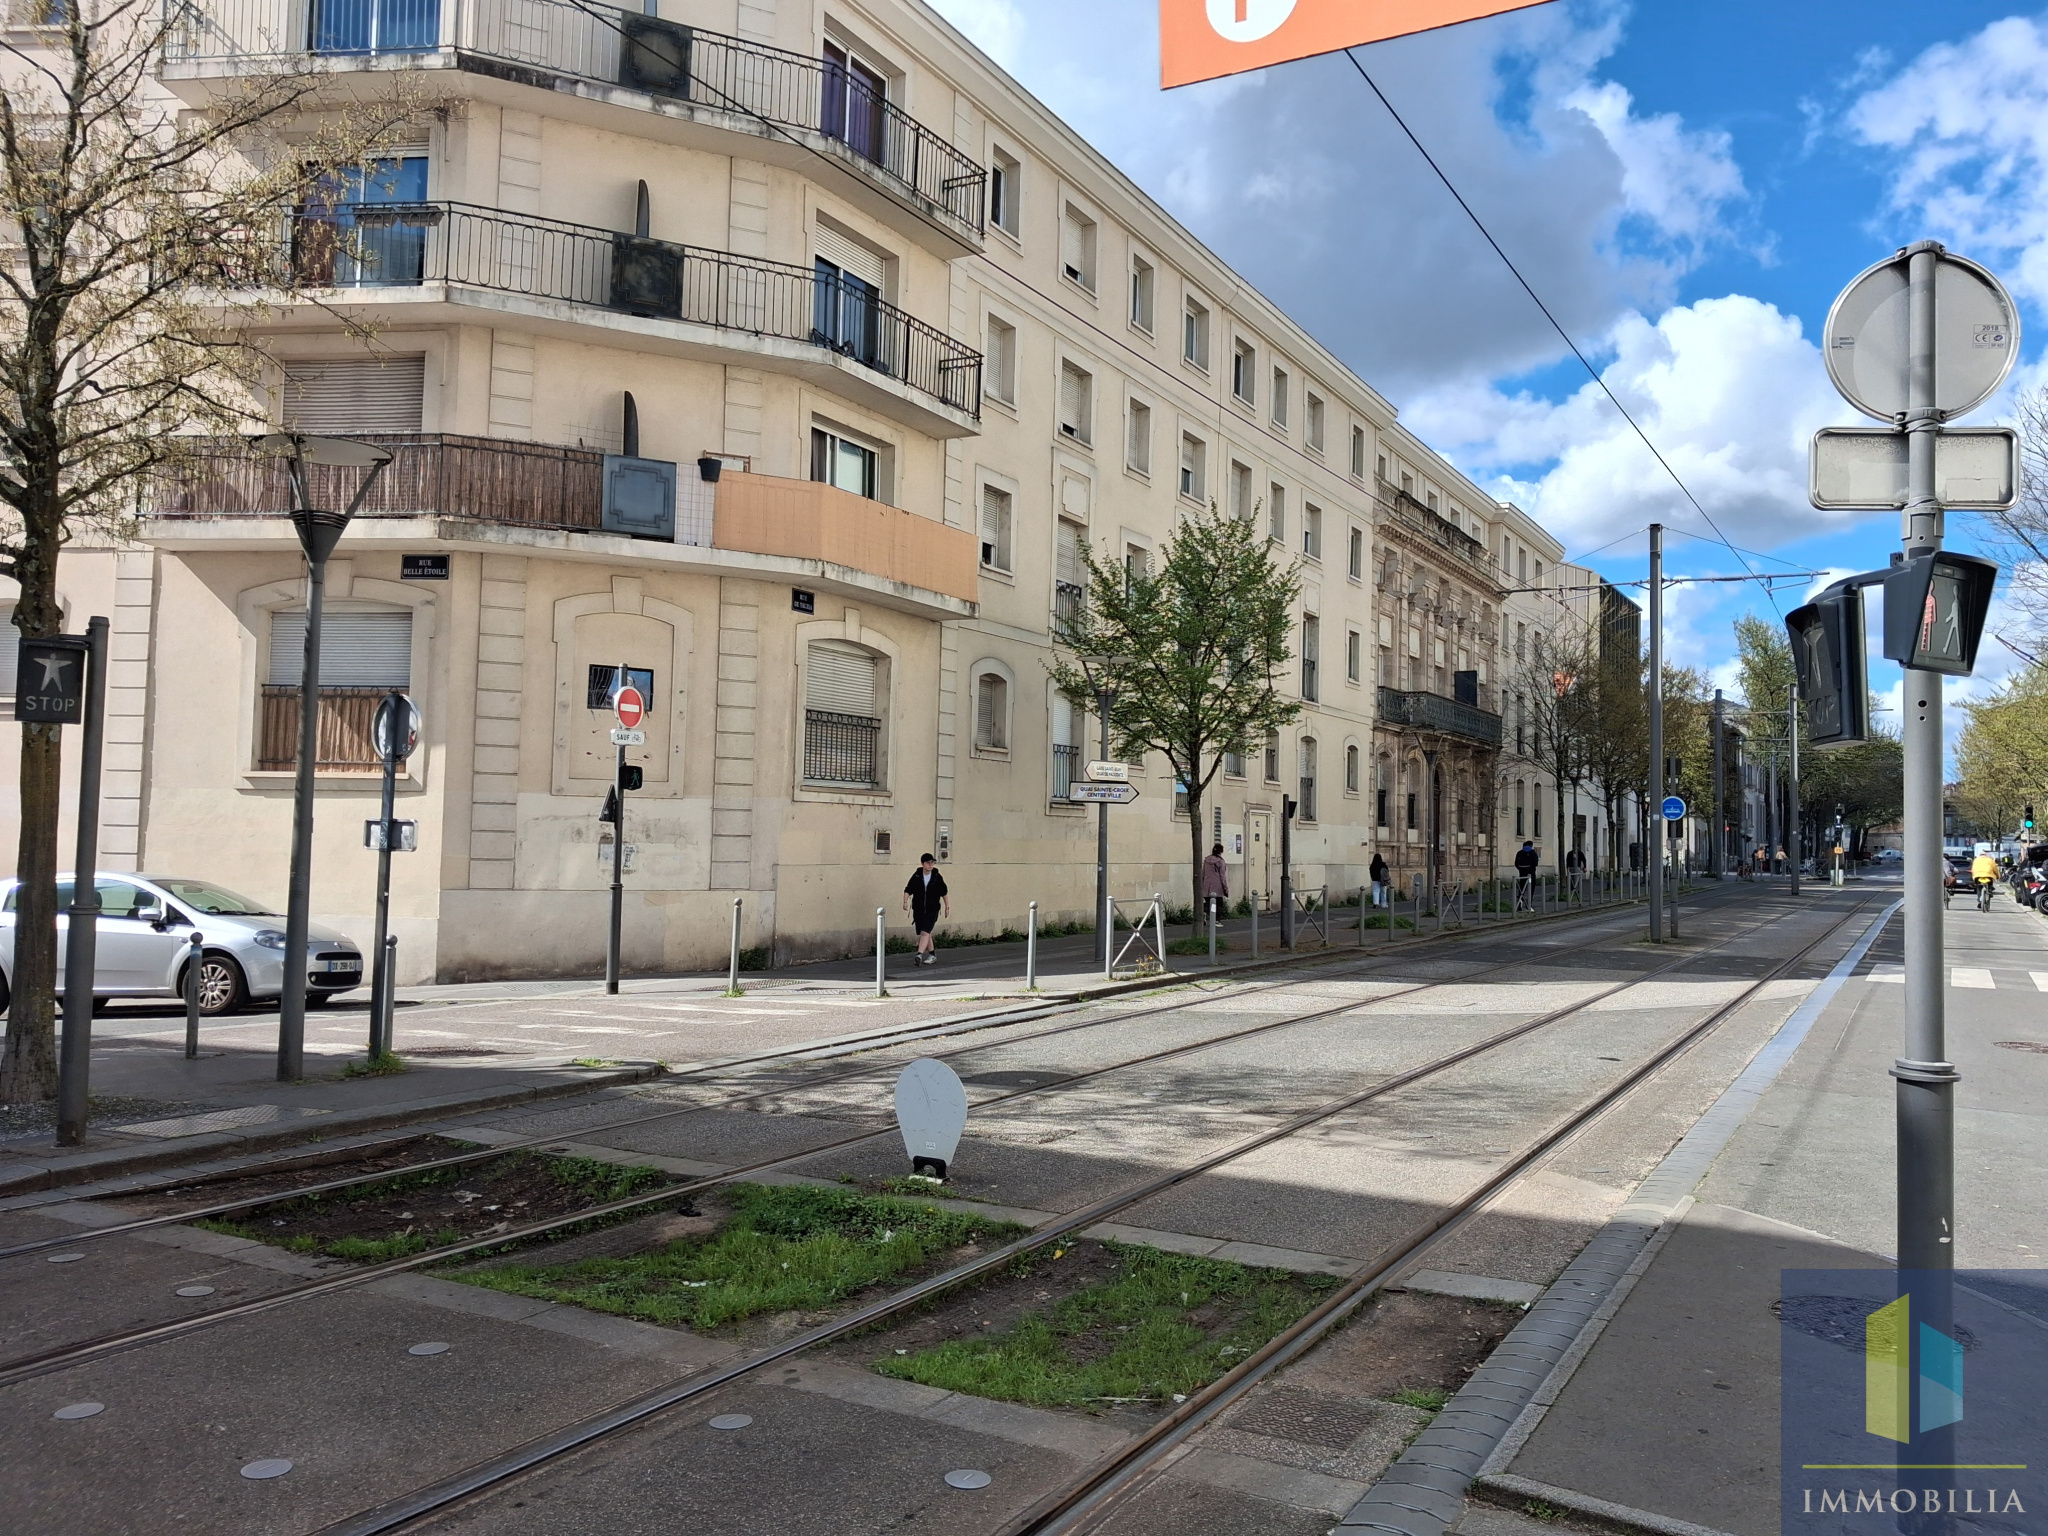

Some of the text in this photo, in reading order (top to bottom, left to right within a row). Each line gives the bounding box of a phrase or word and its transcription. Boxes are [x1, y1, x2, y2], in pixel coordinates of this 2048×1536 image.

[424, 566, 447, 575] ÉTOILE
[25, 695, 75, 713] STOP
[616, 733, 630, 741] SAUF
